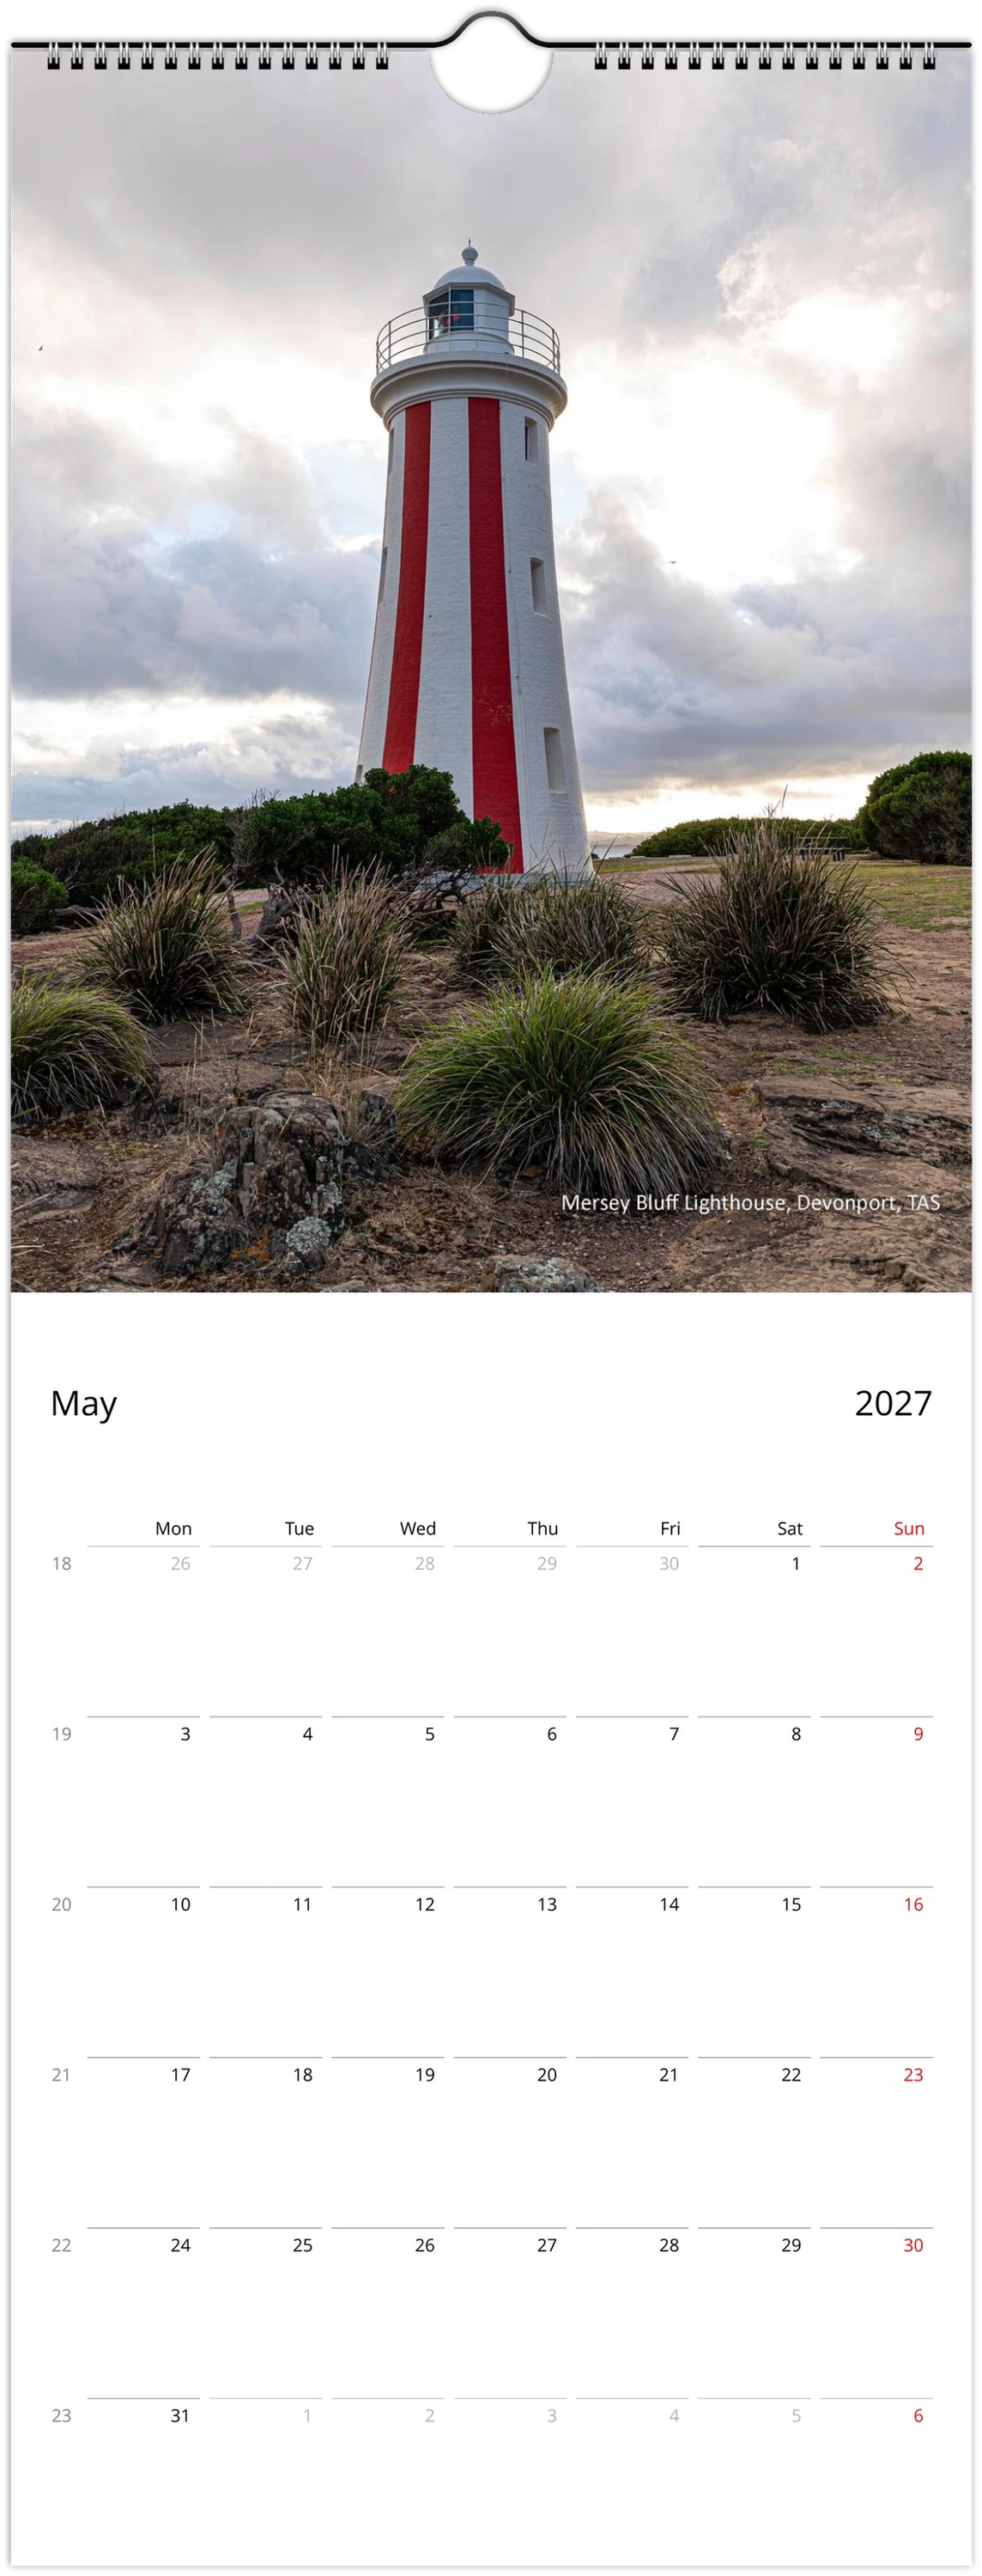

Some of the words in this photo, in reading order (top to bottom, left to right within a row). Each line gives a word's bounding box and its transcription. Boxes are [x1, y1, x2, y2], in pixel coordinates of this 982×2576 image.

[52, 1389, 118, 1425] May
[855, 1389, 933, 1417] 2027
[155, 1521, 192, 1536] Mon
[284, 1521, 315, 1536] Tue
[399, 1520, 436, 1536] Wed
[526, 1520, 559, 1536] Thu
[661, 1521, 681, 1536] Fri
[777, 1521, 804, 1536] Sat
[894, 1521, 925, 1536] Sun
[52, 1556, 72, 1571] 18
[171, 1556, 191, 1571] 26
[293, 1556, 313, 1571] 27
[415, 1556, 435, 1571] 28
[537, 1556, 557, 1571] 29
[659, 1556, 680, 1571] 30
[792, 1556, 799, 1571] 1
[912, 1556, 924, 1571] 2
[52, 1726, 72, 1741] 19
[180, 1726, 191, 1741] 3
[302, 1726, 314, 1741] 4
[425, 1726, 435, 1741] 5
[547, 1726, 557, 1741] 6
[669, 1726, 680, 1741] 7
[791, 1726, 802, 1741] 8
[913, 1726, 924, 1741] 9
[52, 1897, 72, 1912] 20
[171, 1897, 191, 1912] 10
[294, 1897, 310, 1912] 11
[415, 1897, 435, 1912] 12
[537, 1897, 557, 1912] 13
[660, 1897, 681, 1912] 14
[782, 1897, 802, 1912] 15
[904, 1897, 924, 1912] 16
[52, 2067, 69, 2082] 21
[172, 2067, 191, 2082] 17
[294, 2067, 313, 2082] 18
[415, 2067, 435, 2082] 19
[536, 2067, 557, 2082] 20
[659, 2067, 676, 2082] 21
[781, 2067, 802, 2082] 22
[903, 2067, 924, 2082] 23
[52, 2238, 72, 2253] 22
[170, 2238, 191, 2253] 24
[292, 2238, 313, 2253] 25
[415, 2238, 435, 2253] 26
[536, 2238, 557, 2253] 27
[659, 2238, 680, 2253] 28
[781, 2238, 802, 2253] 29
[903, 2238, 924, 2253] 30
[52, 2408, 72, 2423] 23
[170, 2408, 188, 2423] 31
[304, 2409, 310, 2422] 1
[425, 2408, 435, 2423] 2
[547, 2409, 557, 2423] 3
[669, 2409, 680, 2422] 4
[791, 2409, 802, 2423] 5
[913, 2408, 924, 2424] 6
